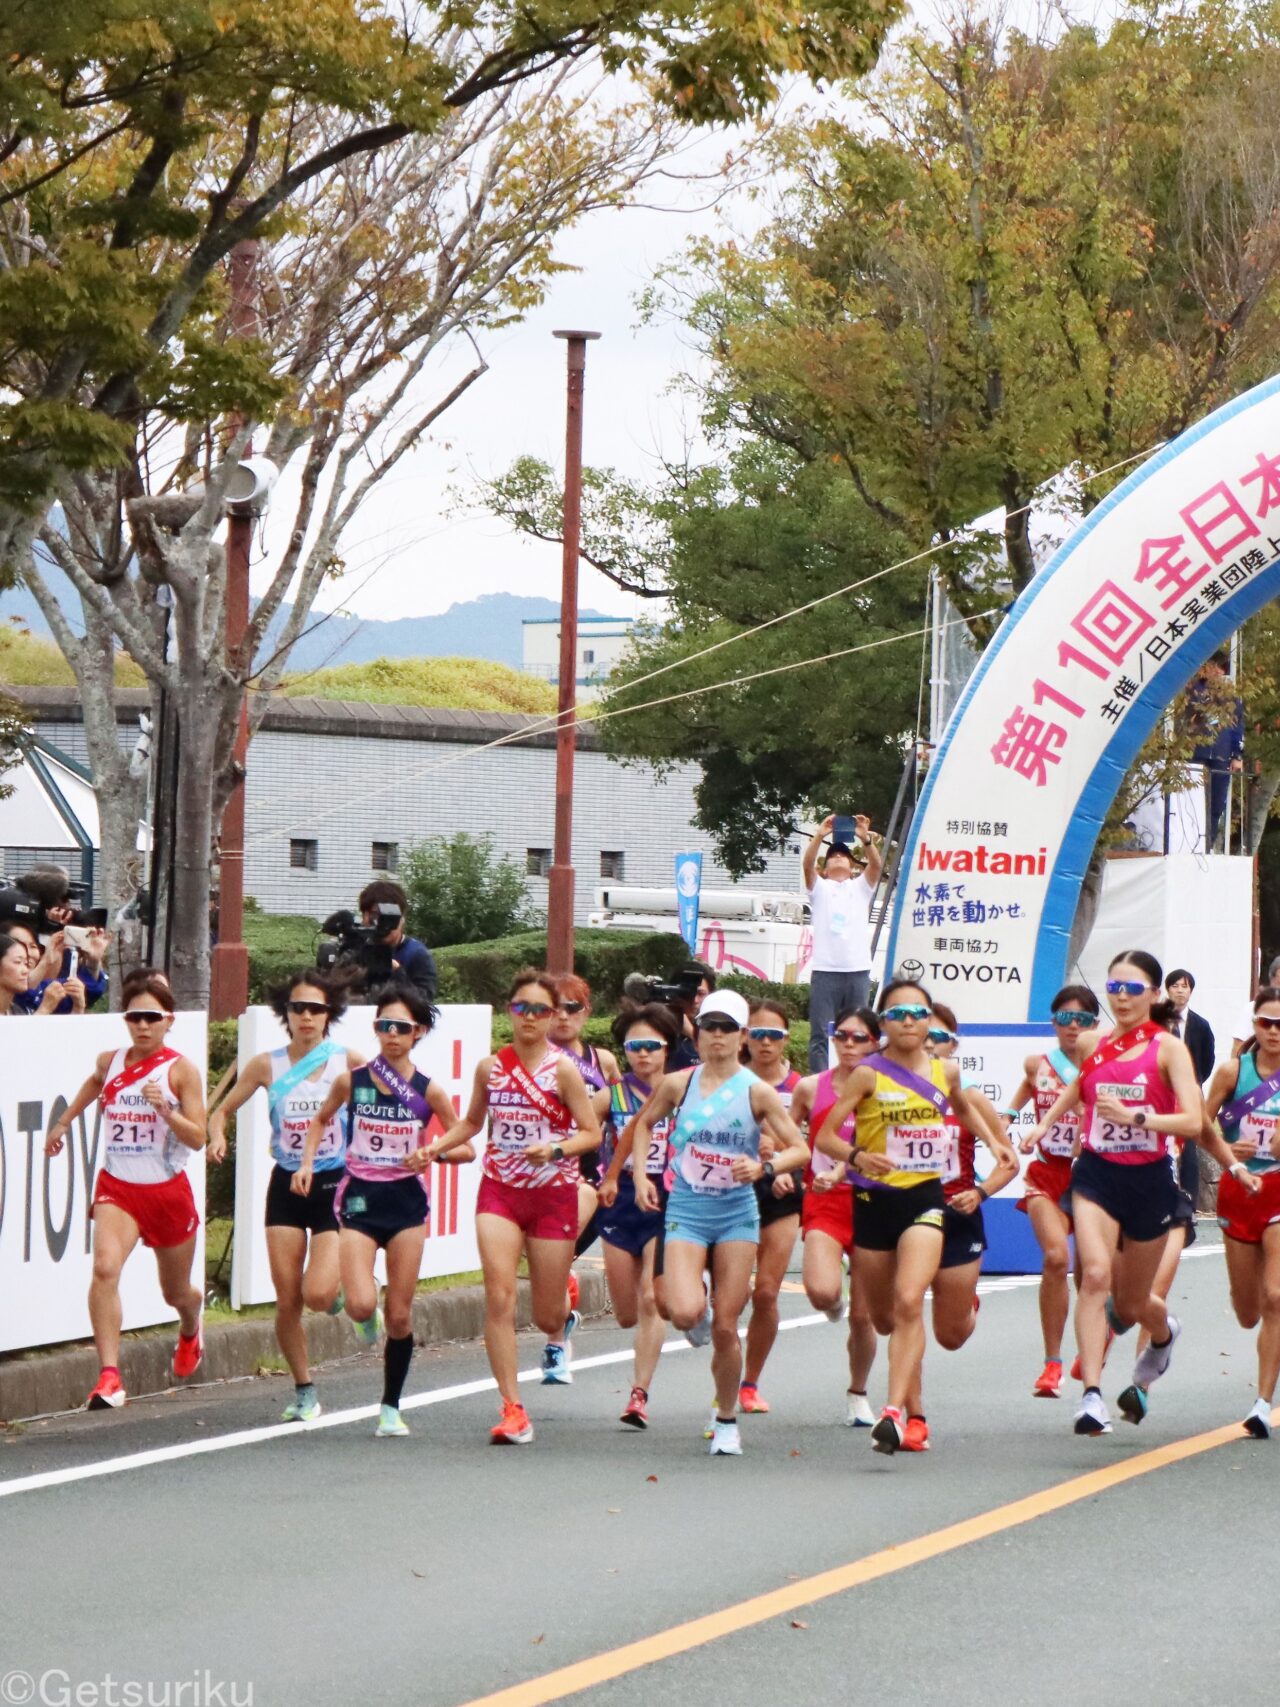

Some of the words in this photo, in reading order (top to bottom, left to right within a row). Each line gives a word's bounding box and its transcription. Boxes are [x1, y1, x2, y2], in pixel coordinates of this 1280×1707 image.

[947, 820, 1009, 837] 特別協賛
[918, 842, 1047, 875] Iwatani
[915, 882, 966, 904] 水素で
[934, 937, 999, 953] 車両協力
[930, 963, 1022, 984] TOYOTA
[356, 1104, 394, 1118] ROUTE
[881, 1107, 941, 1121] HITACH
[112, 1124, 155, 1142] 21-1
[358, 1119, 413, 1135] Iwatani
[501, 1122, 542, 1141] 29-1
